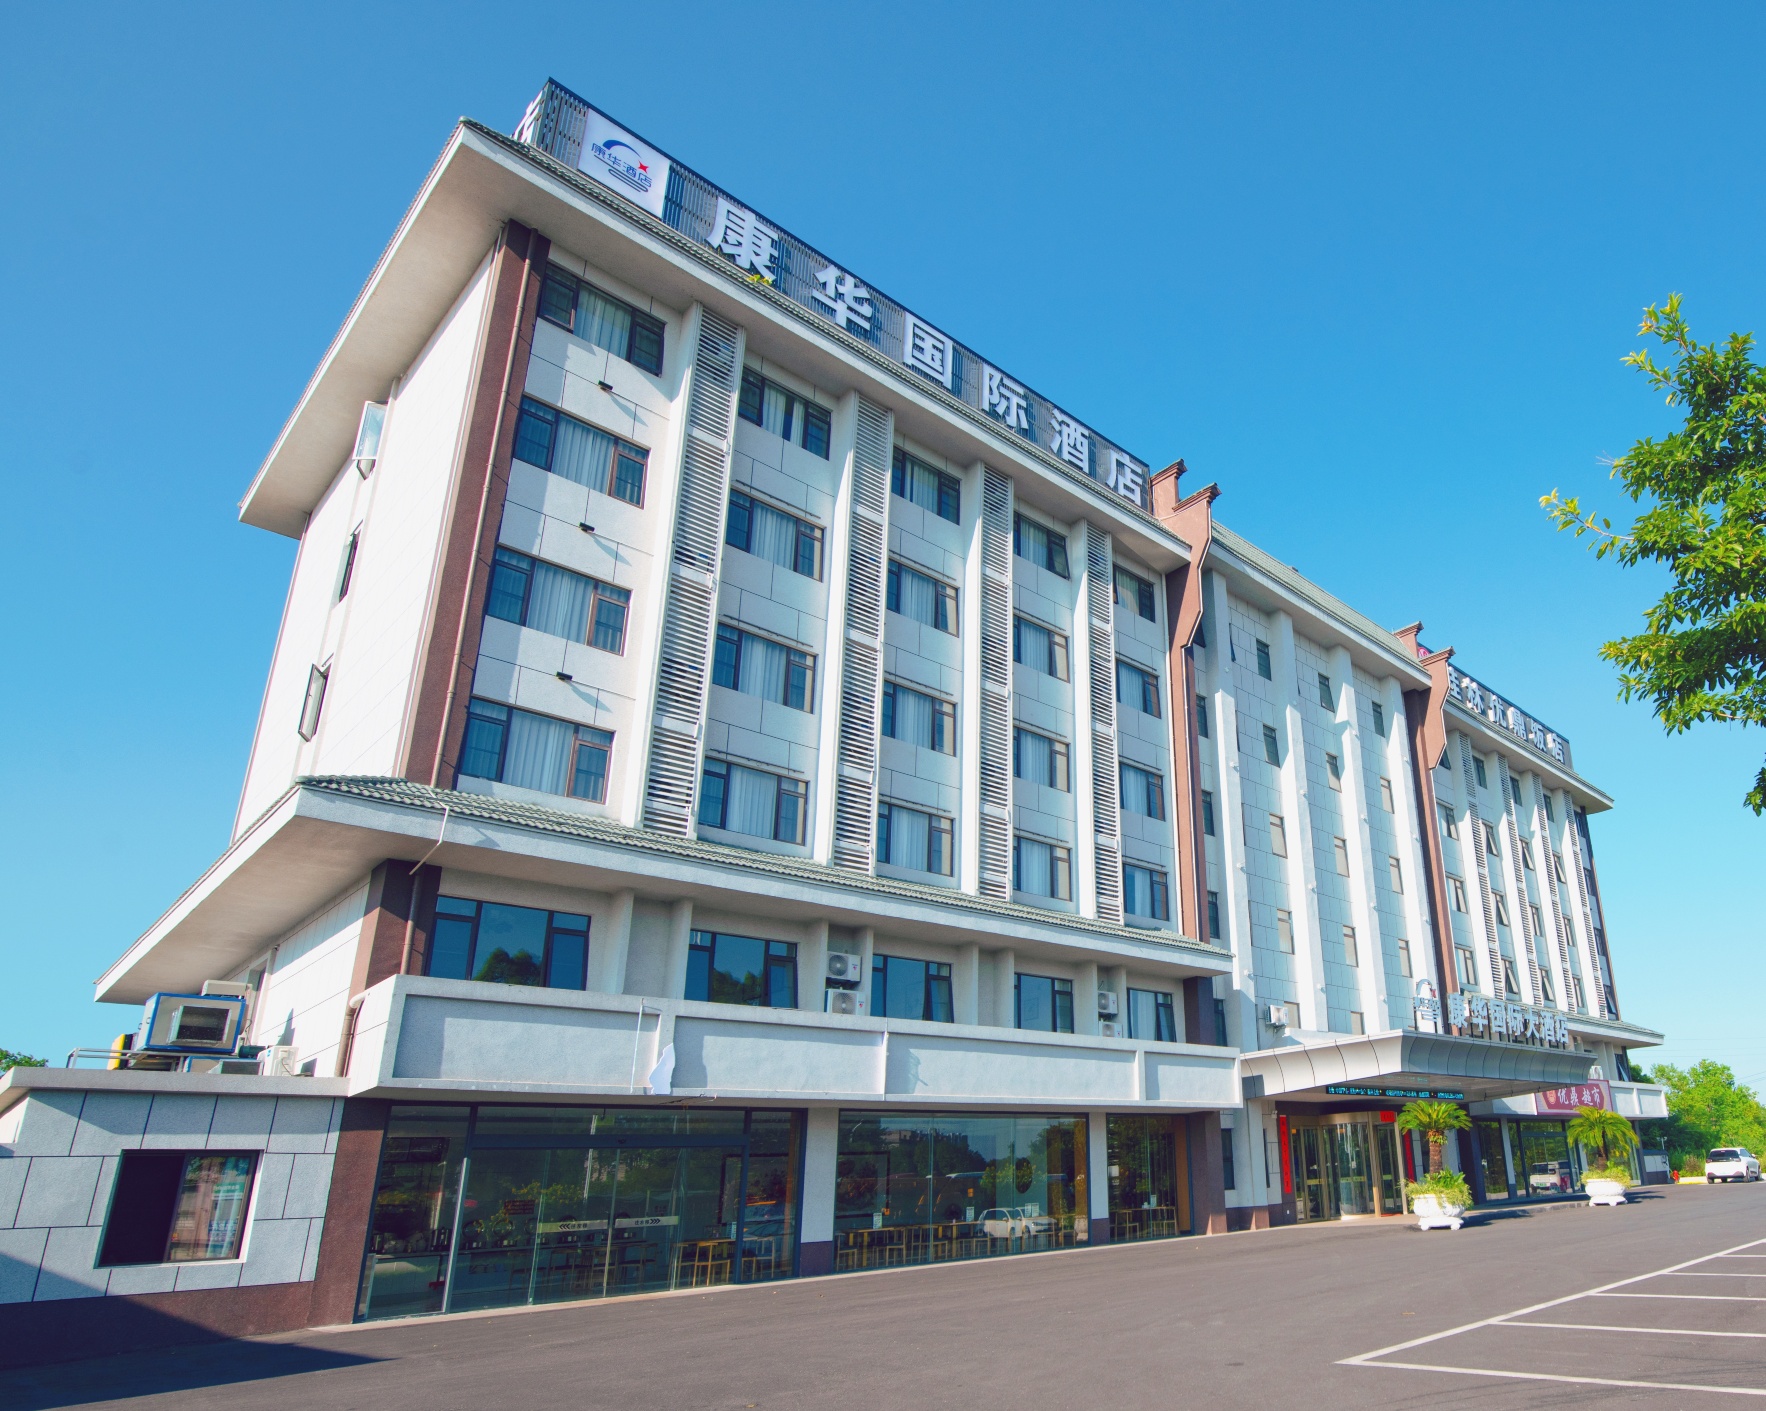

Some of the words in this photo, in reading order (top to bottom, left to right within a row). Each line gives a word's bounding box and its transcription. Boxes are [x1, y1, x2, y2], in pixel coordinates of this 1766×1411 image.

[591, 143, 652, 188] 康华酒店
[705, 196, 1143, 506] 康华国际酒店
[1448, 993, 1569, 1044] 康华国际大酒店
